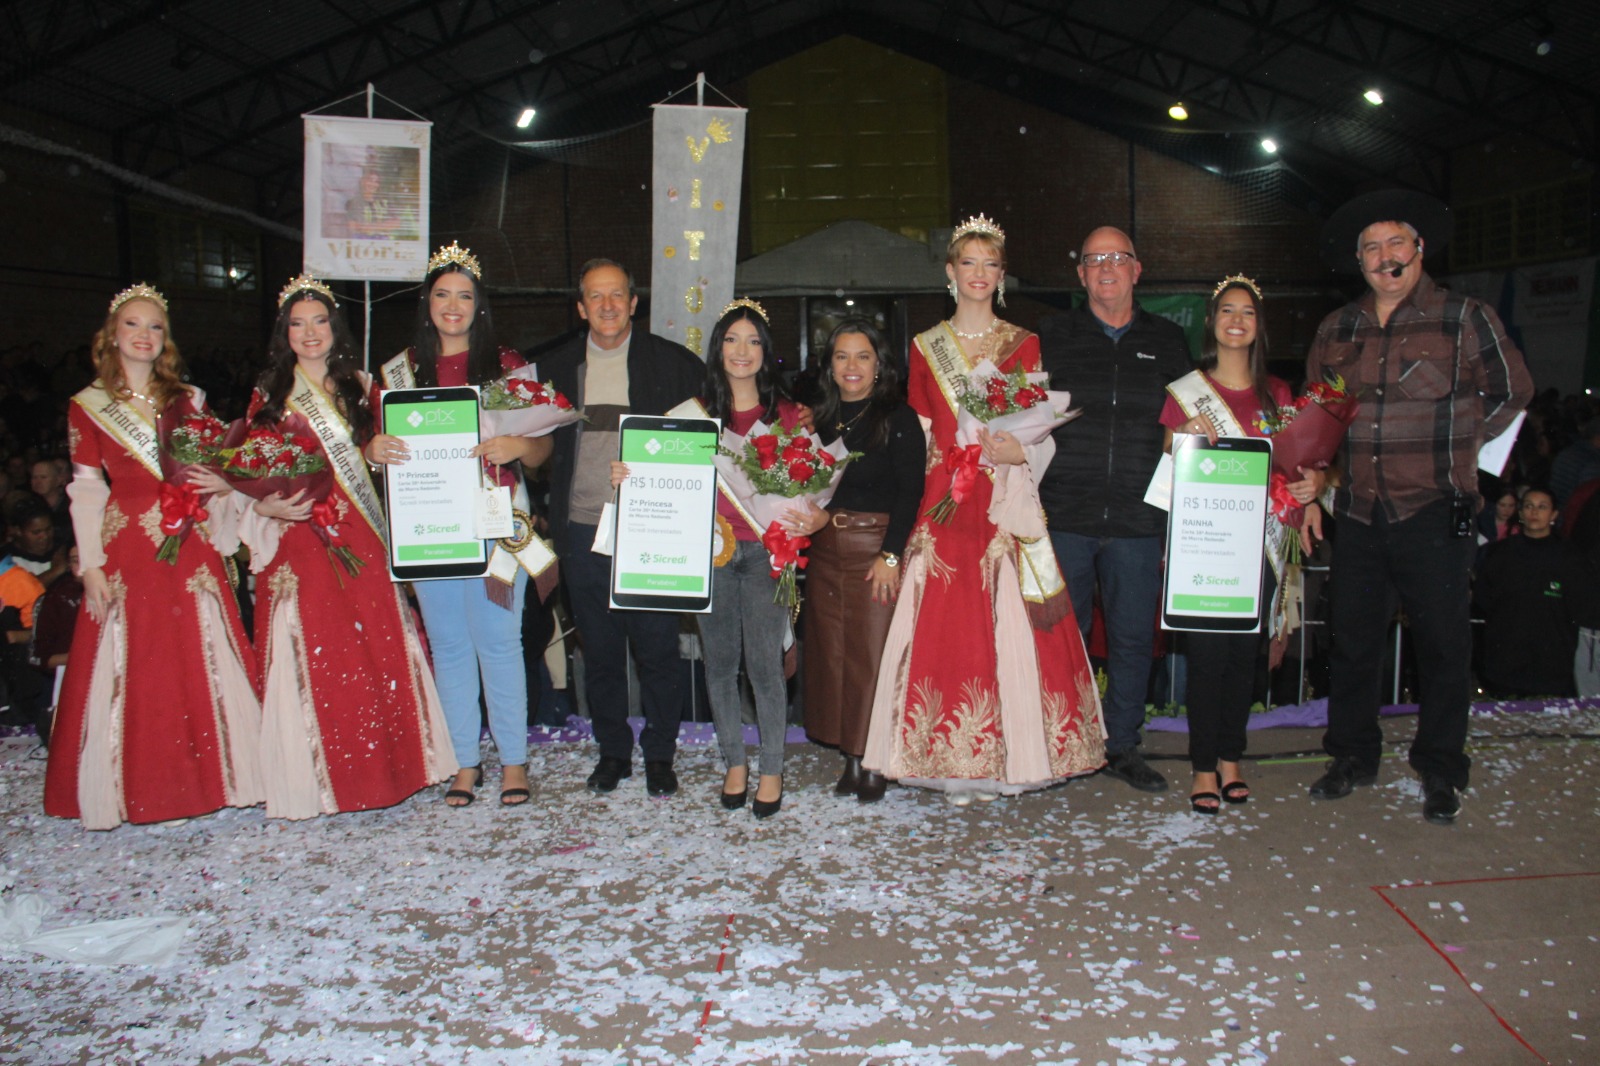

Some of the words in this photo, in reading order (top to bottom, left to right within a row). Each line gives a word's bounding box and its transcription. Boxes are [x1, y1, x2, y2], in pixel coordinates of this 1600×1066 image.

[930, 335, 955, 375] Rainha
[425, 408, 456, 425] pix
[99, 402, 150, 447] Princesa
[293, 389, 335, 442] Princesa
[328, 442, 357, 482] Morro
[663, 437, 694, 454] pix
[1218, 457, 1249, 474] pix
[406, 471, 439, 480] Princesa
[630, 477, 646, 489] R$
[649, 477, 702, 491] 1.000,00
[639, 499, 673, 508] Princesa
[1183, 497, 1200, 510] R$
[1203, 497, 1255, 512] 1.500,00
[426, 523, 461, 534] Sicredi
[1182, 518, 1213, 528] RAINHA
[652, 553, 688, 565] Sicredi
[1206, 575, 1240, 586] Sicredi
